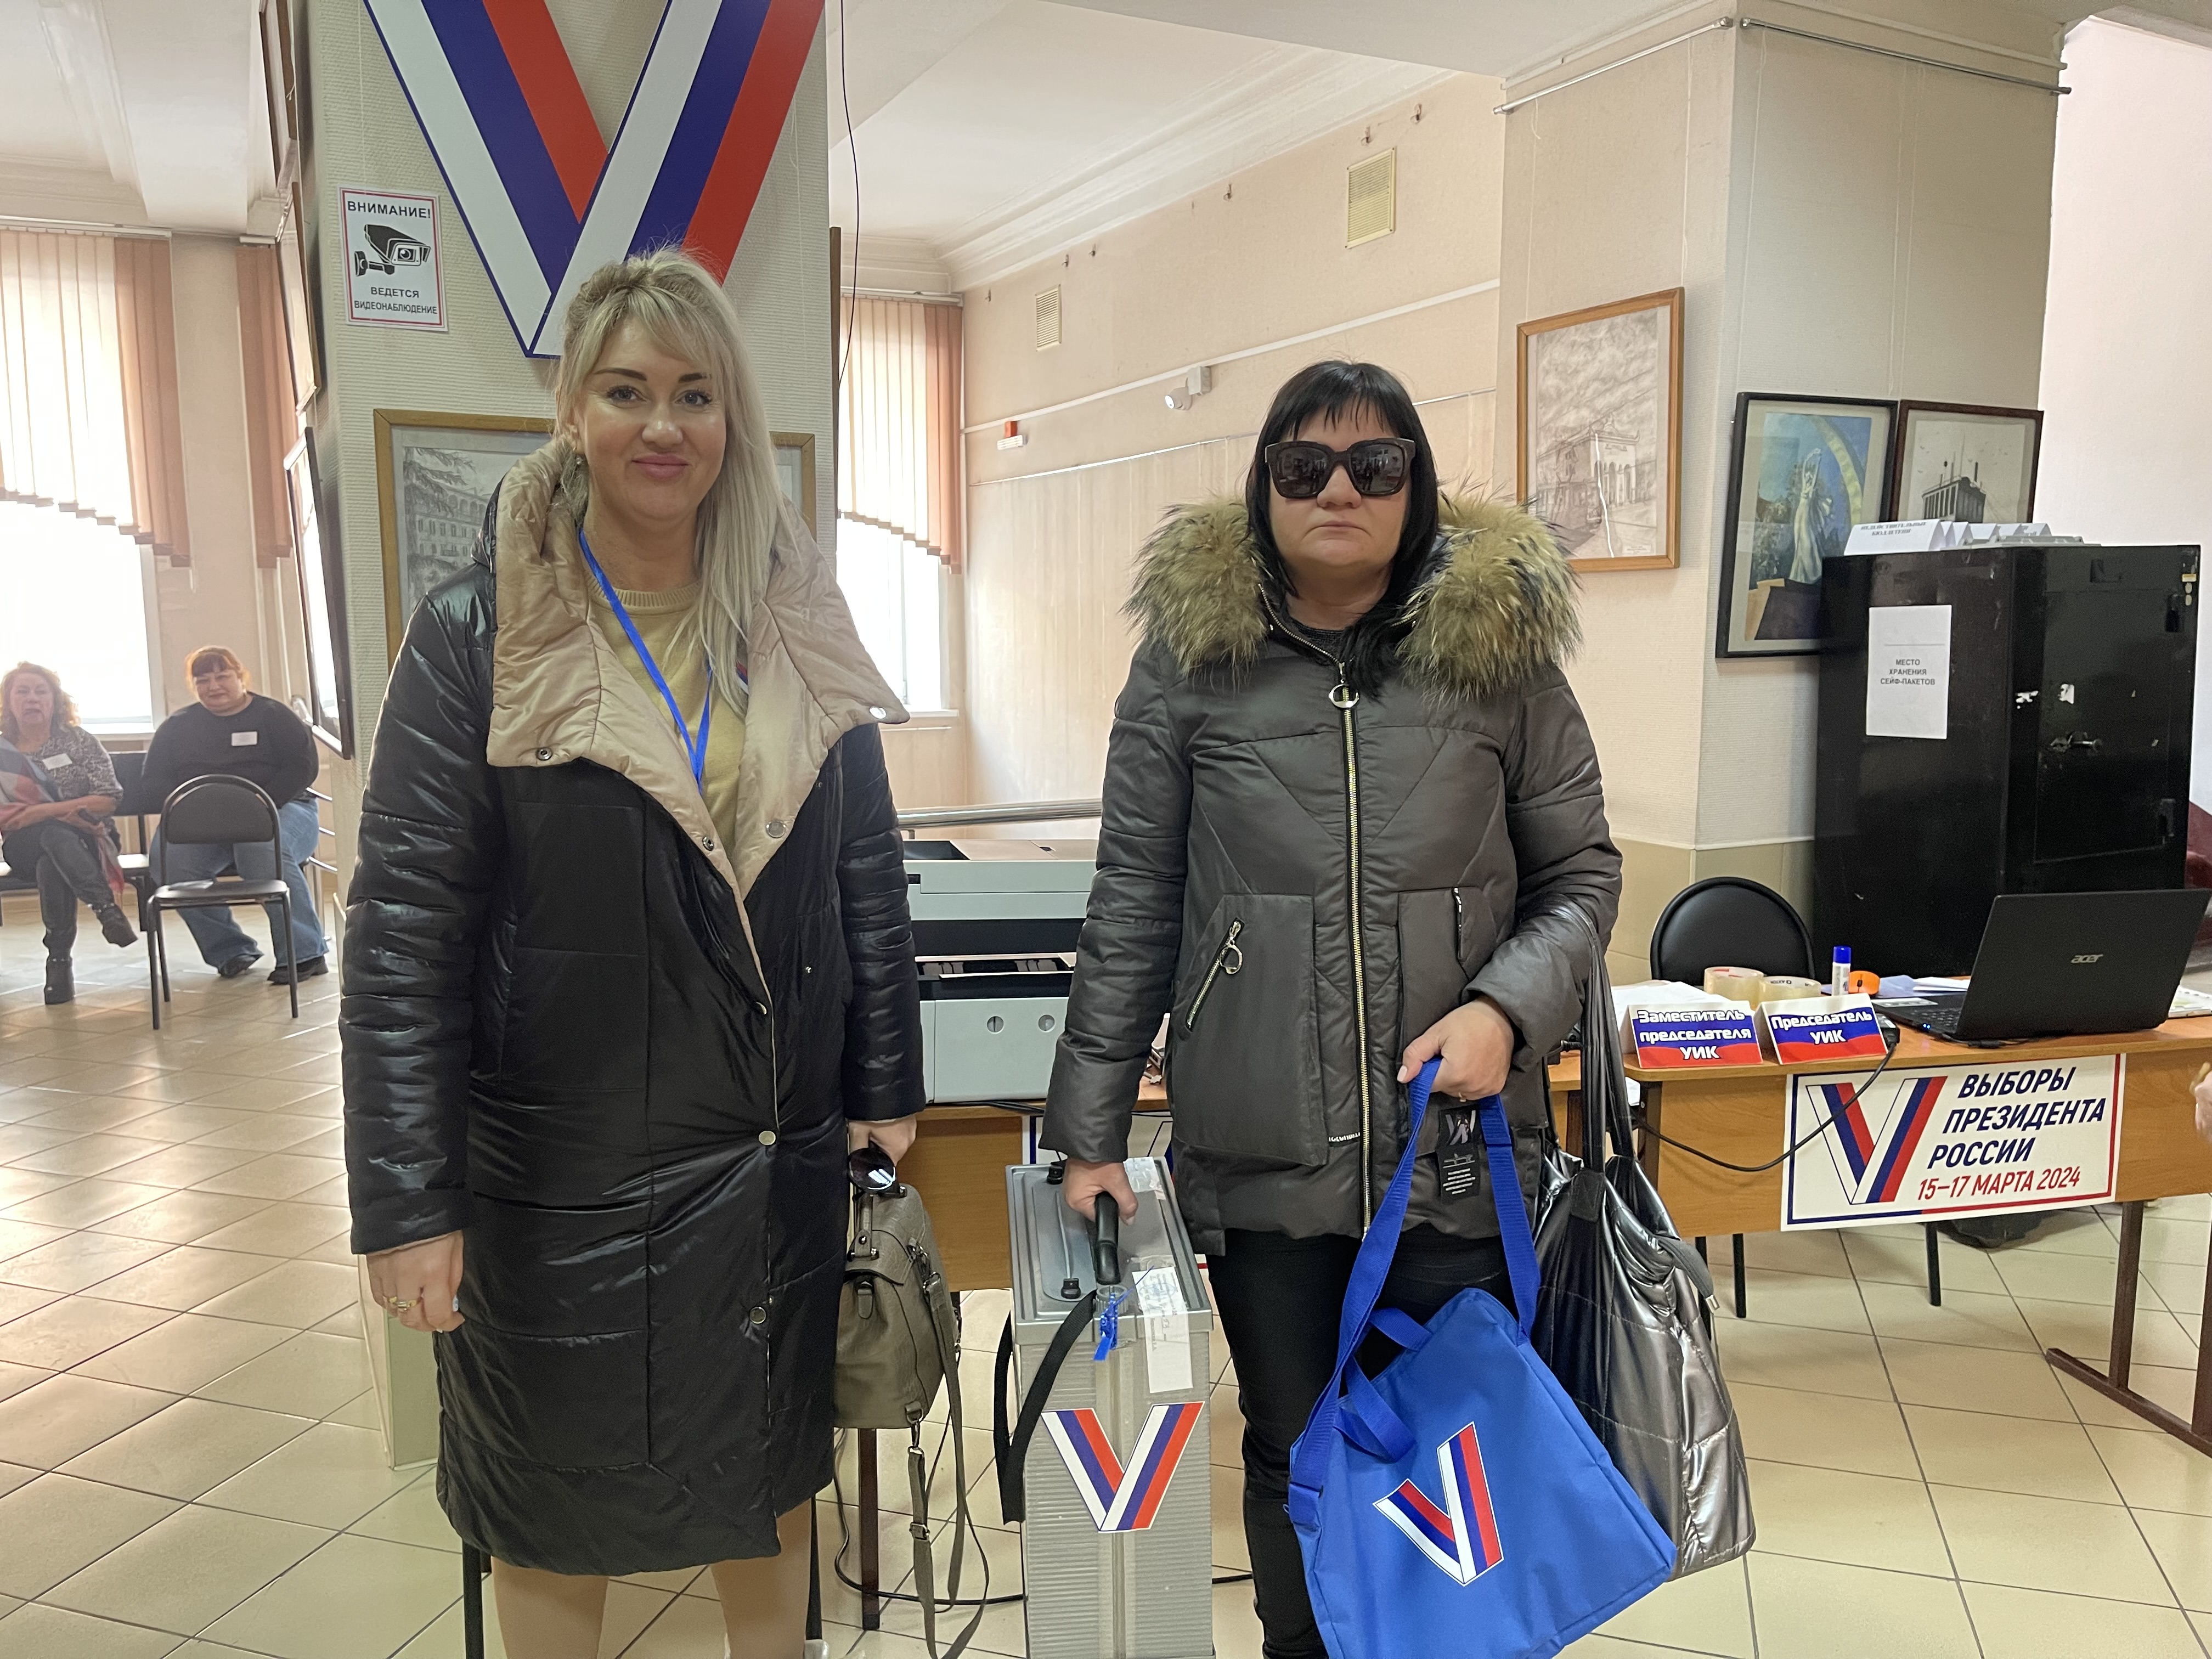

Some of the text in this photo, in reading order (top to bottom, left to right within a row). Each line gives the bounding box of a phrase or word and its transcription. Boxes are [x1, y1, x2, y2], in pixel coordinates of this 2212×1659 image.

[347, 201, 431, 218] ВНИМАНИЕ!
[371, 287, 419, 298] ВЕДЕТСЯ
[354, 301, 437, 314] ВИДЕОНАБЛЮДЕНИЕ
[1880, 676, 1936, 685] СЕЙФ-ПАКЕТОВ
[2070, 953, 2103, 963] acer
[1638, 1011, 1745, 1023] Заместитель
[1771, 1011, 1872, 1031] Председатель
[1639, 1028, 1752, 1042] председателя
[1809, 1029, 1846, 1045] УИК
[1679, 1046, 1719, 1059] УИК
[1958, 1067, 2076, 1098] ВЫБОРЫ
[1943, 1098, 2107, 1134] ПРЕЗИДЕНТА
[1927, 1137, 2036, 1169] РОССИИ
[1971, 1172, 2033, 1197] МАРТА
[2037, 1166, 2081, 1190] 2024
